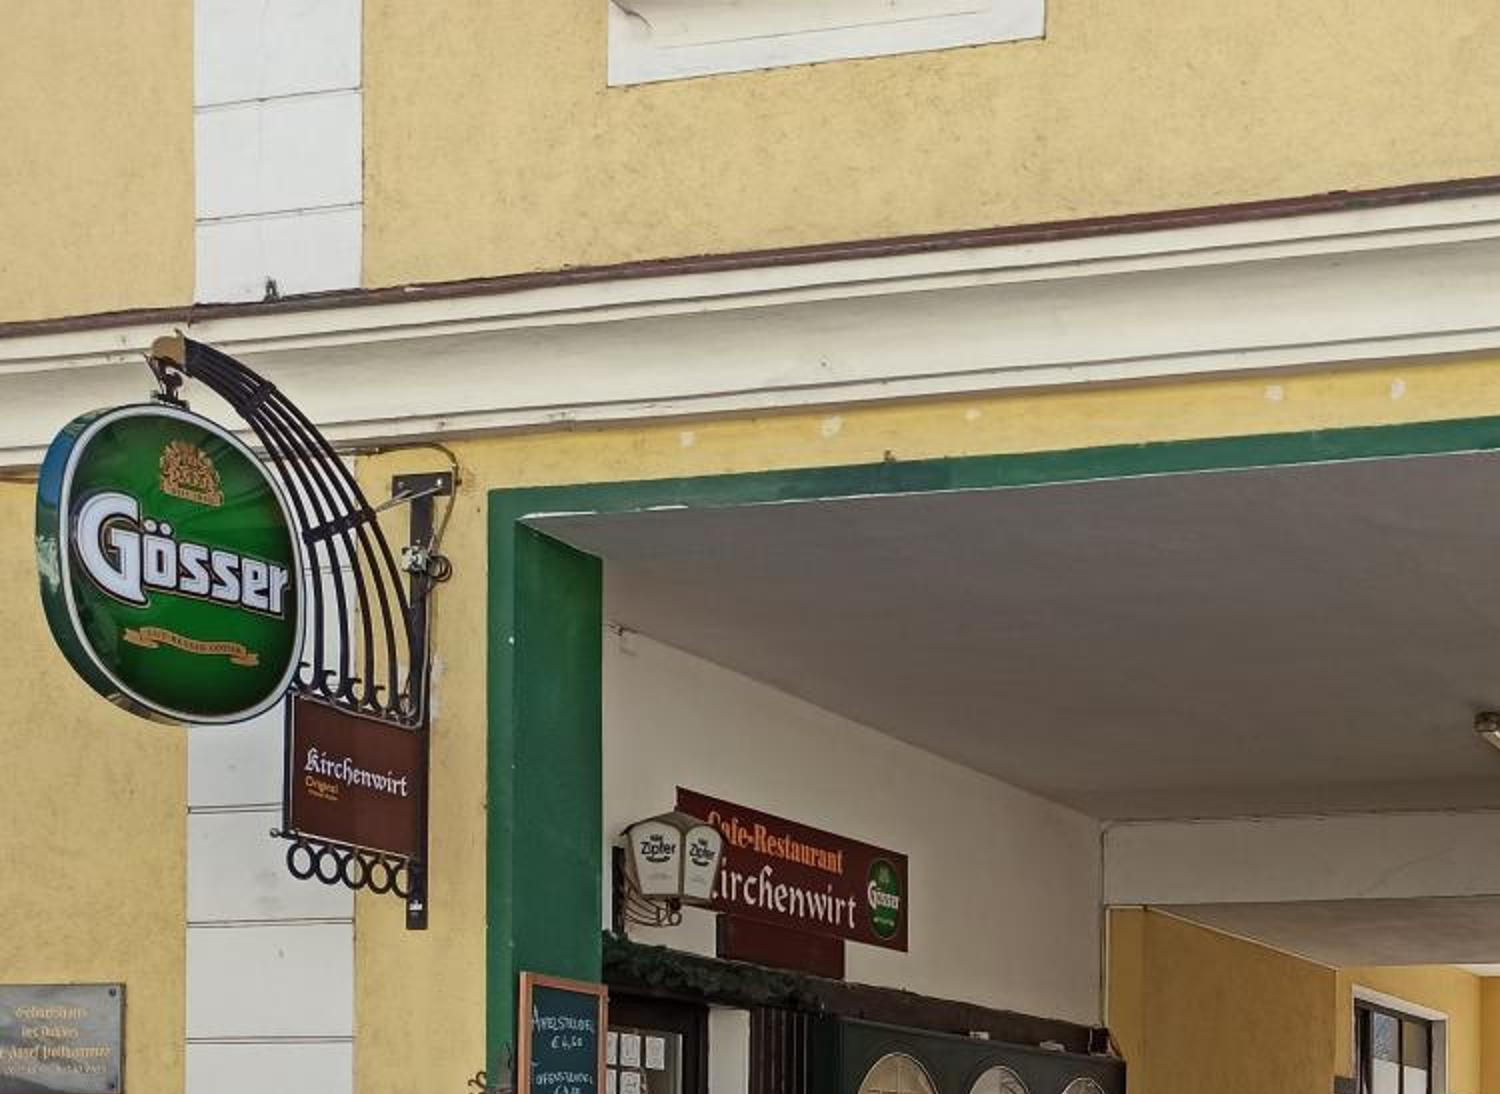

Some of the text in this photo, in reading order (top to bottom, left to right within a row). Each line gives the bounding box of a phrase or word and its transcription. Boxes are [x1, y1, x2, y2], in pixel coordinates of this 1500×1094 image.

[76, 491, 289, 614] Gösser
[304, 747, 408, 797] Kirchenwirt
[640, 841, 676, 857] Zipfer
[712, 857, 856, 929] irchenwirt
